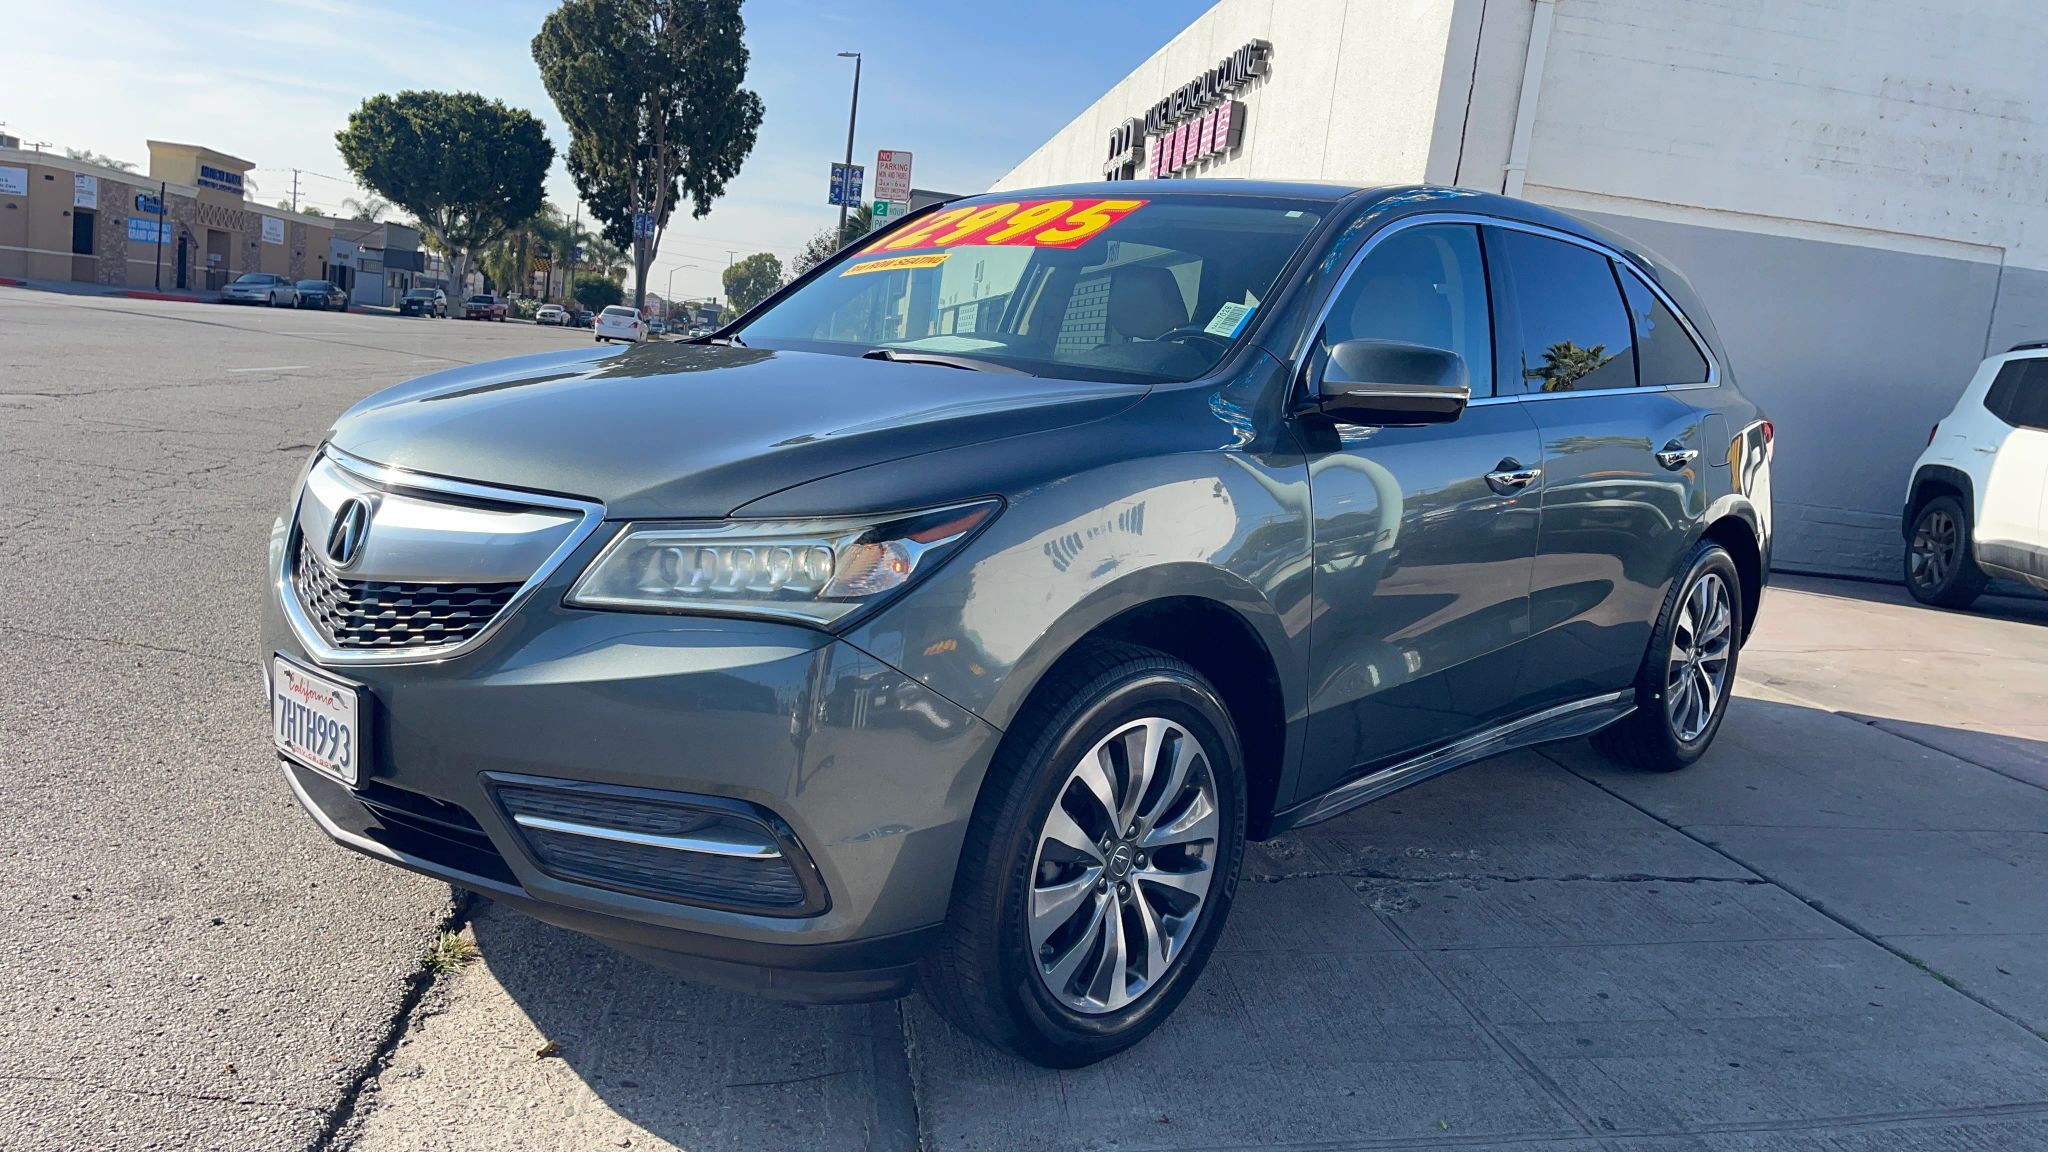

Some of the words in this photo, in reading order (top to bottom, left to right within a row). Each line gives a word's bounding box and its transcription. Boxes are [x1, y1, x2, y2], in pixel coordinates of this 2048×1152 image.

[1144, 97, 1170, 136] DUKE
[1168, 70, 1214, 122] MEDICAL
[1215, 38, 1260, 93] CLINIC
[880, 151, 891, 161] NO
[880, 162, 908, 172] PARKING
[876, 203, 885, 215] 2
[889, 207, 905, 217] HOUR
[129, 229, 147, 241] GRAND
[288, 672, 340, 711] California
[278, 693, 351, 767] 7HTH993
